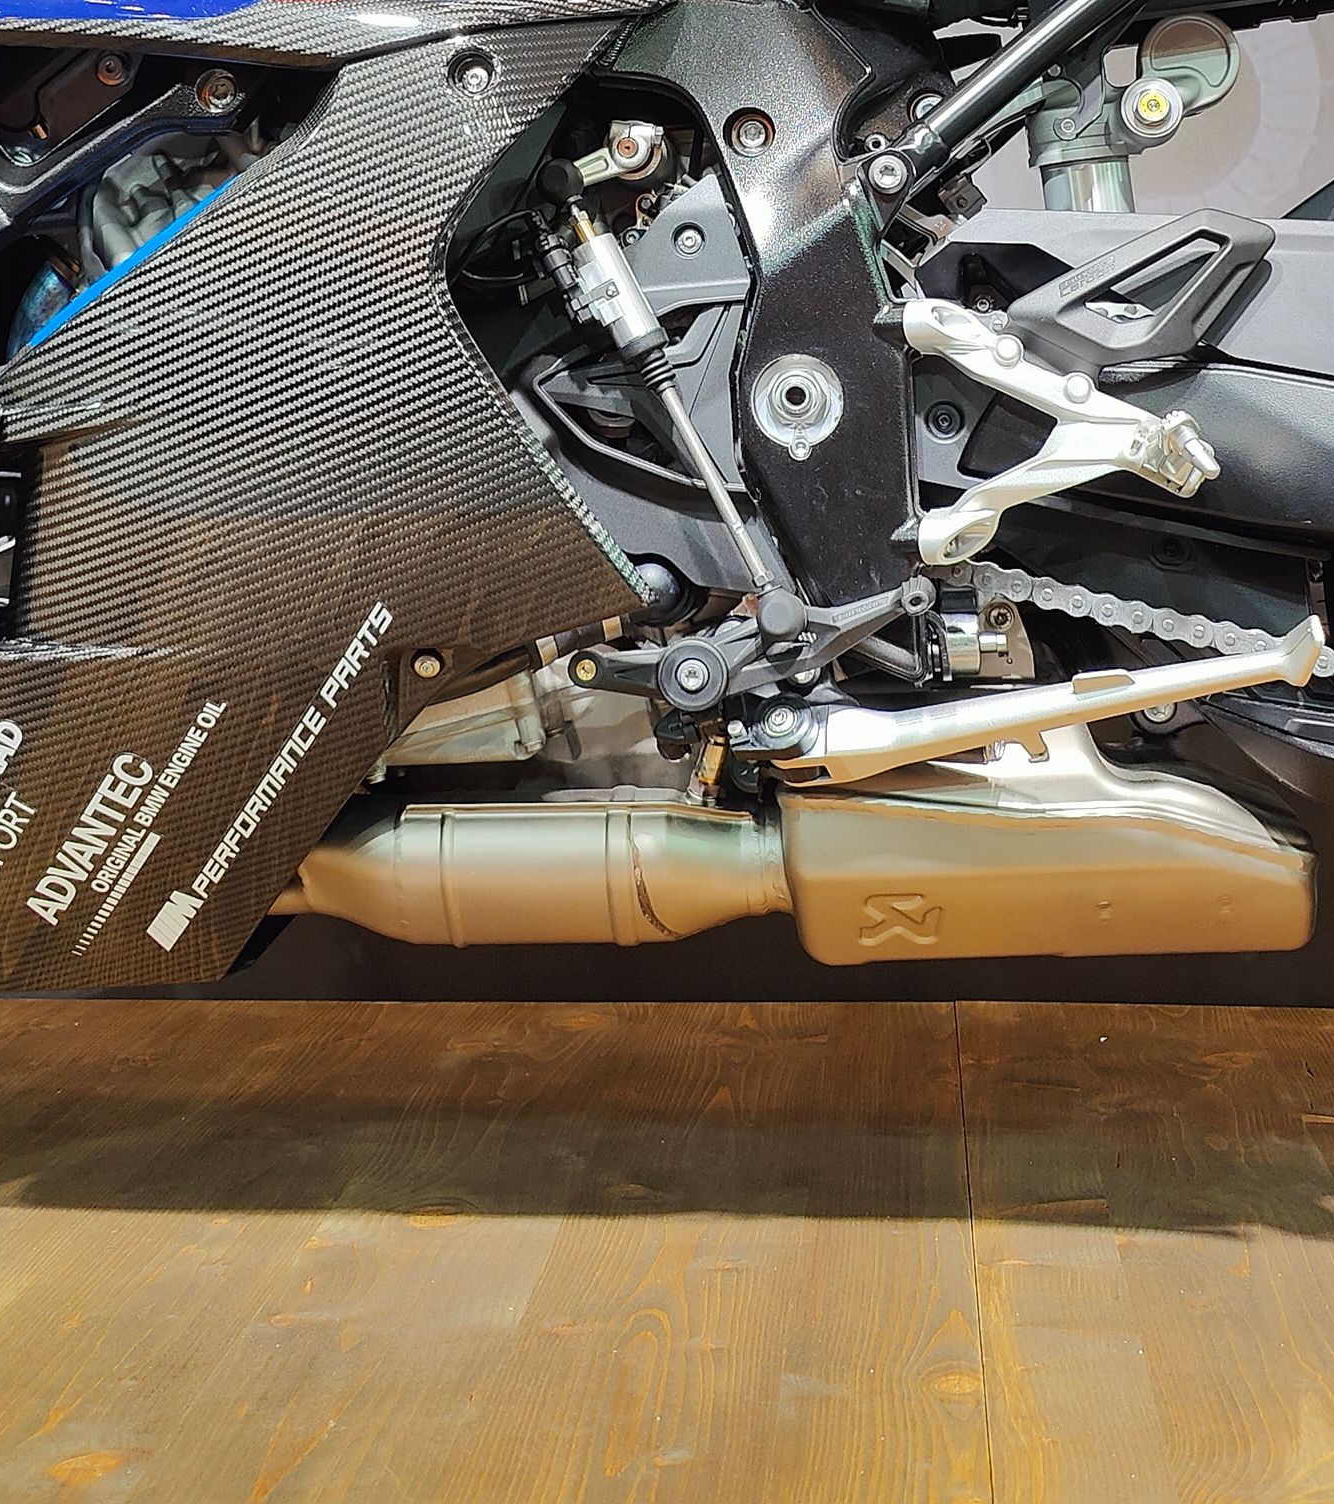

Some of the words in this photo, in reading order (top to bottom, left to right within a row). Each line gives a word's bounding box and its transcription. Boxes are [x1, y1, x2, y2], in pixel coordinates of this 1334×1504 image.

[26, 753, 153, 926] ADVANTEC
[90, 827, 146, 894] ORIGINAL
[133, 784, 170, 828] BMW
[154, 726, 209, 790] ENGINE
[196, 699, 227, 730] OIL
[191, 705, 327, 898] PERFORMANCE
[320, 601, 394, 708] PARTS
